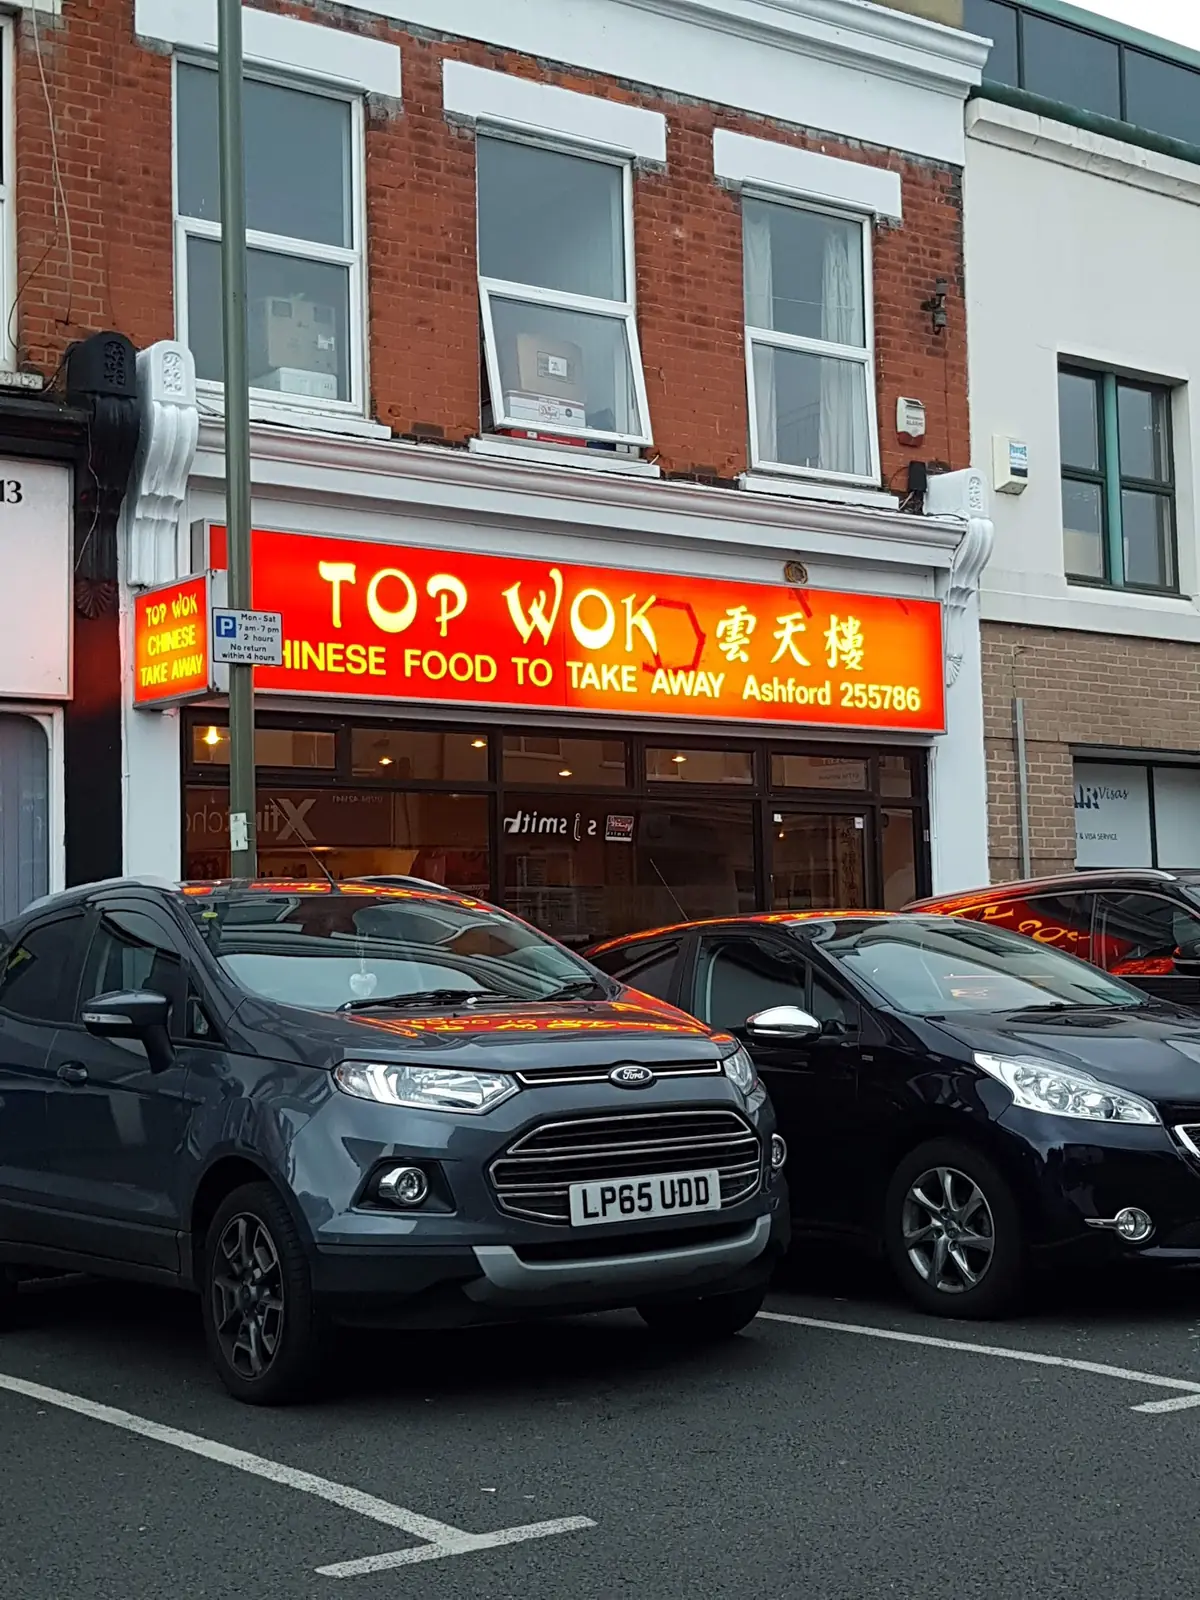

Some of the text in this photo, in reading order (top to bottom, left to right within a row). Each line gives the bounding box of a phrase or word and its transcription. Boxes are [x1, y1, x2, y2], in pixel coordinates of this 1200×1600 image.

[145, 592, 198, 628] TOP WOK
[318, 560, 659, 655] TOP WOK
[147, 623, 196, 656] CHINESE
[220, 618, 234, 636] P
[243, 633, 274, 643] 2 hours
[716, 605, 864, 671] 雲天樓
[221, 651, 275, 661] within 4 hours
[230, 643, 242, 651] No
[140, 653, 203, 687] TAKE AWAY
[403, 648, 498, 684] FOOD
[511, 657, 553, 688] TO
[566, 660, 638, 693] TAKE
[650, 670, 725, 699] AWAY
[742, 674, 831, 706] Ashford
[839, 682, 921, 712] 255786
[1098, 786, 1130, 800] Visas
[622, 1068, 645, 1080] Ford
[581, 1176, 710, 1219] LP65 UDD
